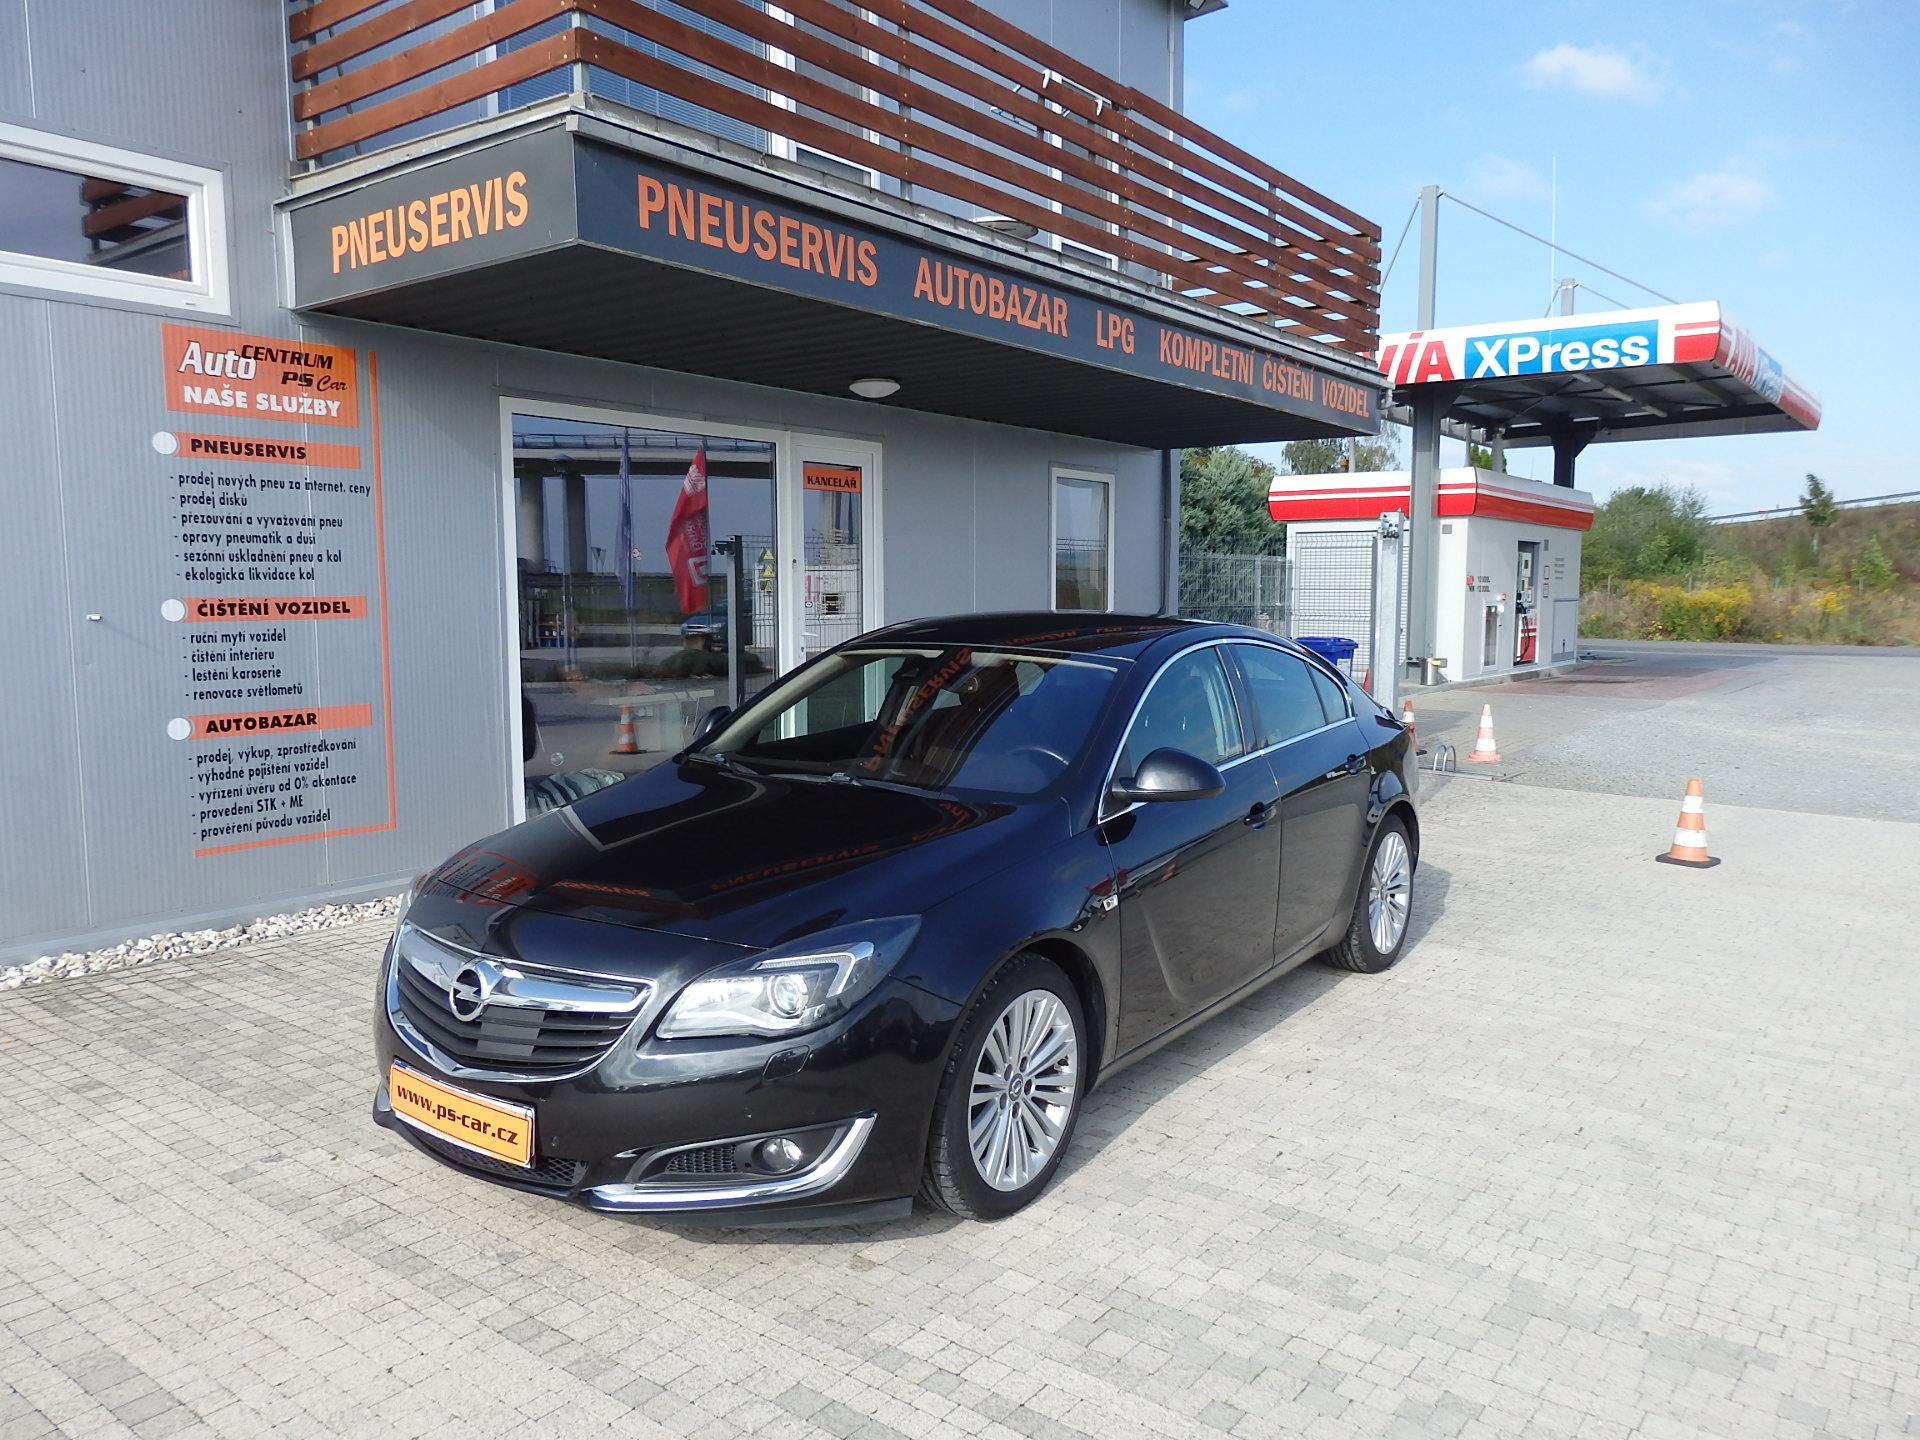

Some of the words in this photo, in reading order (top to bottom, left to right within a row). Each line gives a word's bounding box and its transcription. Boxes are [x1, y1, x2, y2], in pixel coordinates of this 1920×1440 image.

[330, 170, 529, 275] PNEUSERVIS
[637, 174, 878, 287] PNEUSERVIS
[913, 256, 1069, 338] AUTOBAZAR
[1095, 309, 1135, 355] LPG
[1159, 328, 1256, 386] KOMPLETNÍ
[1261, 351, 1316, 402] ČIŠTĚNÍ
[1320, 377, 1369, 419] VOZIDEL
[177, 340, 258, 380] Auto
[241, 344, 333, 370] CENTRUM
[1471, 333, 1650, 379] XPress
[281, 371, 314, 388] PS
[316, 375, 348, 392] Car
[184, 383, 247, 409] NAŠE
[256, 392, 341, 417] SLUŽBY
[190, 438, 307, 460] PNEUSERVIS
[179, 471, 214, 489] prodej
[217, 474, 256, 491] nových
[260, 479, 285, 492] pneu
[289, 480, 301, 490] za
[349, 484, 371, 498] ceny
[807, 475, 857, 489] KANCELÁŘ
[180, 490, 216, 509] prodej
[246, 516, 253, 525] a
[319, 517, 343, 530] pneu
[182, 533, 222, 547] opravy
[226, 530, 283, 547] pneumatik
[286, 535, 293, 544] a
[289, 553, 314, 565] pneu
[317, 553, 323, 563] a
[326, 549, 342, 563] kol
[248, 567, 296, 581] likvidace
[299, 567, 315, 581] kol
[197, 599, 269, 617] ČIŠTĚNÍ
[275, 601, 351, 616] VOZIDEL
[249, 628, 287, 642] vozidel
[232, 664, 282, 680] karoserie
[193, 688, 243, 701] renovace
[205, 712, 318, 734] AUTOBAZAR
[294, 756, 329, 772] vozidel
[279, 777, 291, 792] od
[294, 775, 309, 790] 0%
[312, 774, 357, 788] akontace
[256, 797, 278, 813] STK
[289, 794, 304, 809] ME
[295, 807, 332, 824] vozidel
[396, 1084, 519, 1146] www.ps-car.cz
